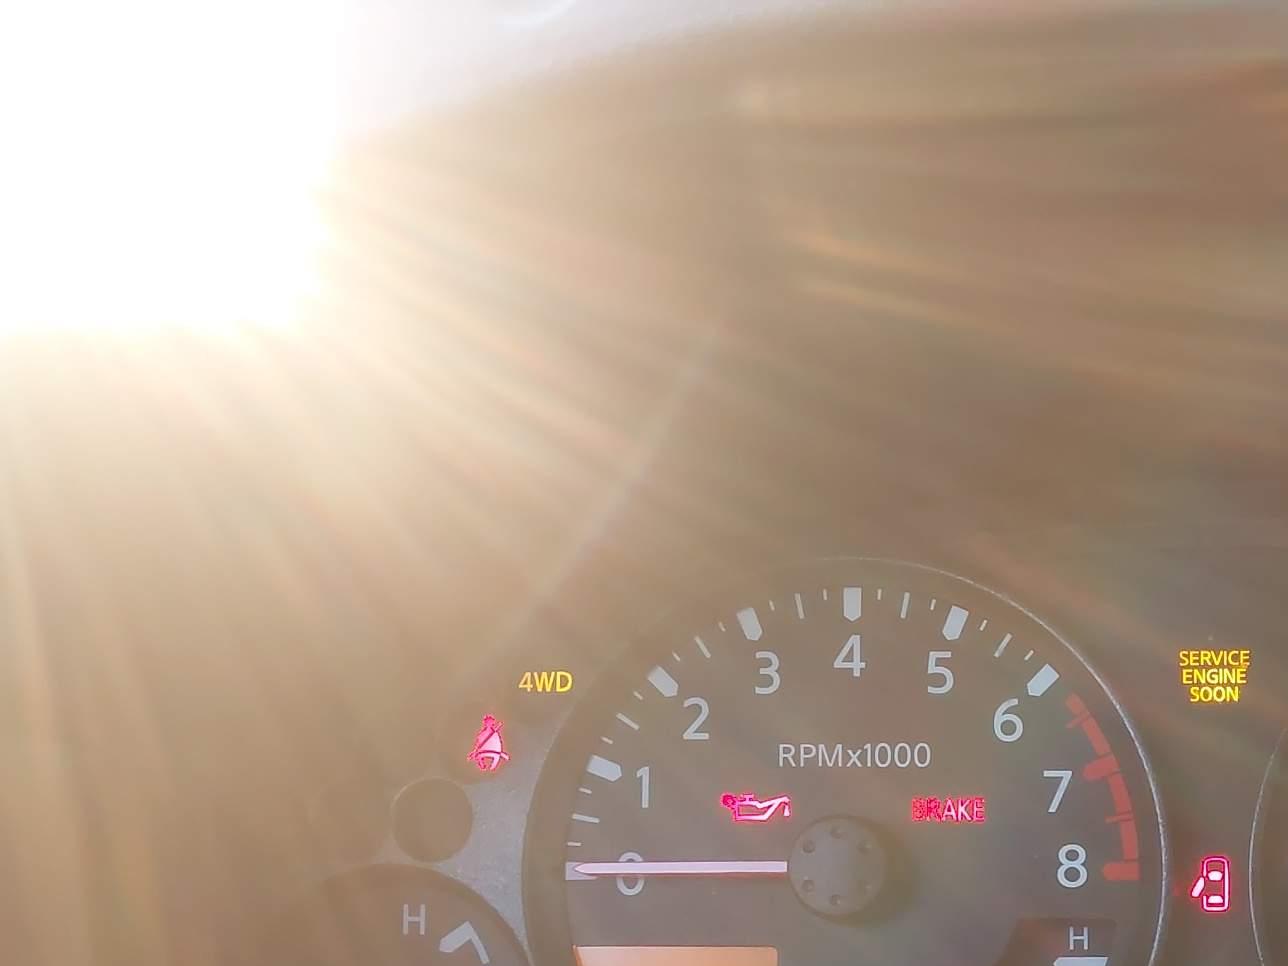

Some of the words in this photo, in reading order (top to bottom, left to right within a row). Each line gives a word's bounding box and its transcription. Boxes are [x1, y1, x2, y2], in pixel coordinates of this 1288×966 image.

[754, 651, 781, 695] 3
[833, 634, 866, 677] 4
[927, 651, 954, 694] 5
[1179, 650, 1250, 666] SERVICE
[518, 671, 573, 693] 4WD
[1182, 668, 1247, 684] ENGINE
[1190, 686, 1239, 702] SOON
[683, 697, 709, 740] 2
[993, 698, 1023, 742] 6
[778, 742, 932, 768] RPMx1000
[635, 766, 650, 809] 1
[1043, 770, 1073, 813] 7
[911, 796, 986, 822] BRAKE
[1056, 844, 1088, 888] 8
[402, 904, 426, 935] H
[1068, 927, 1090, 950] H
